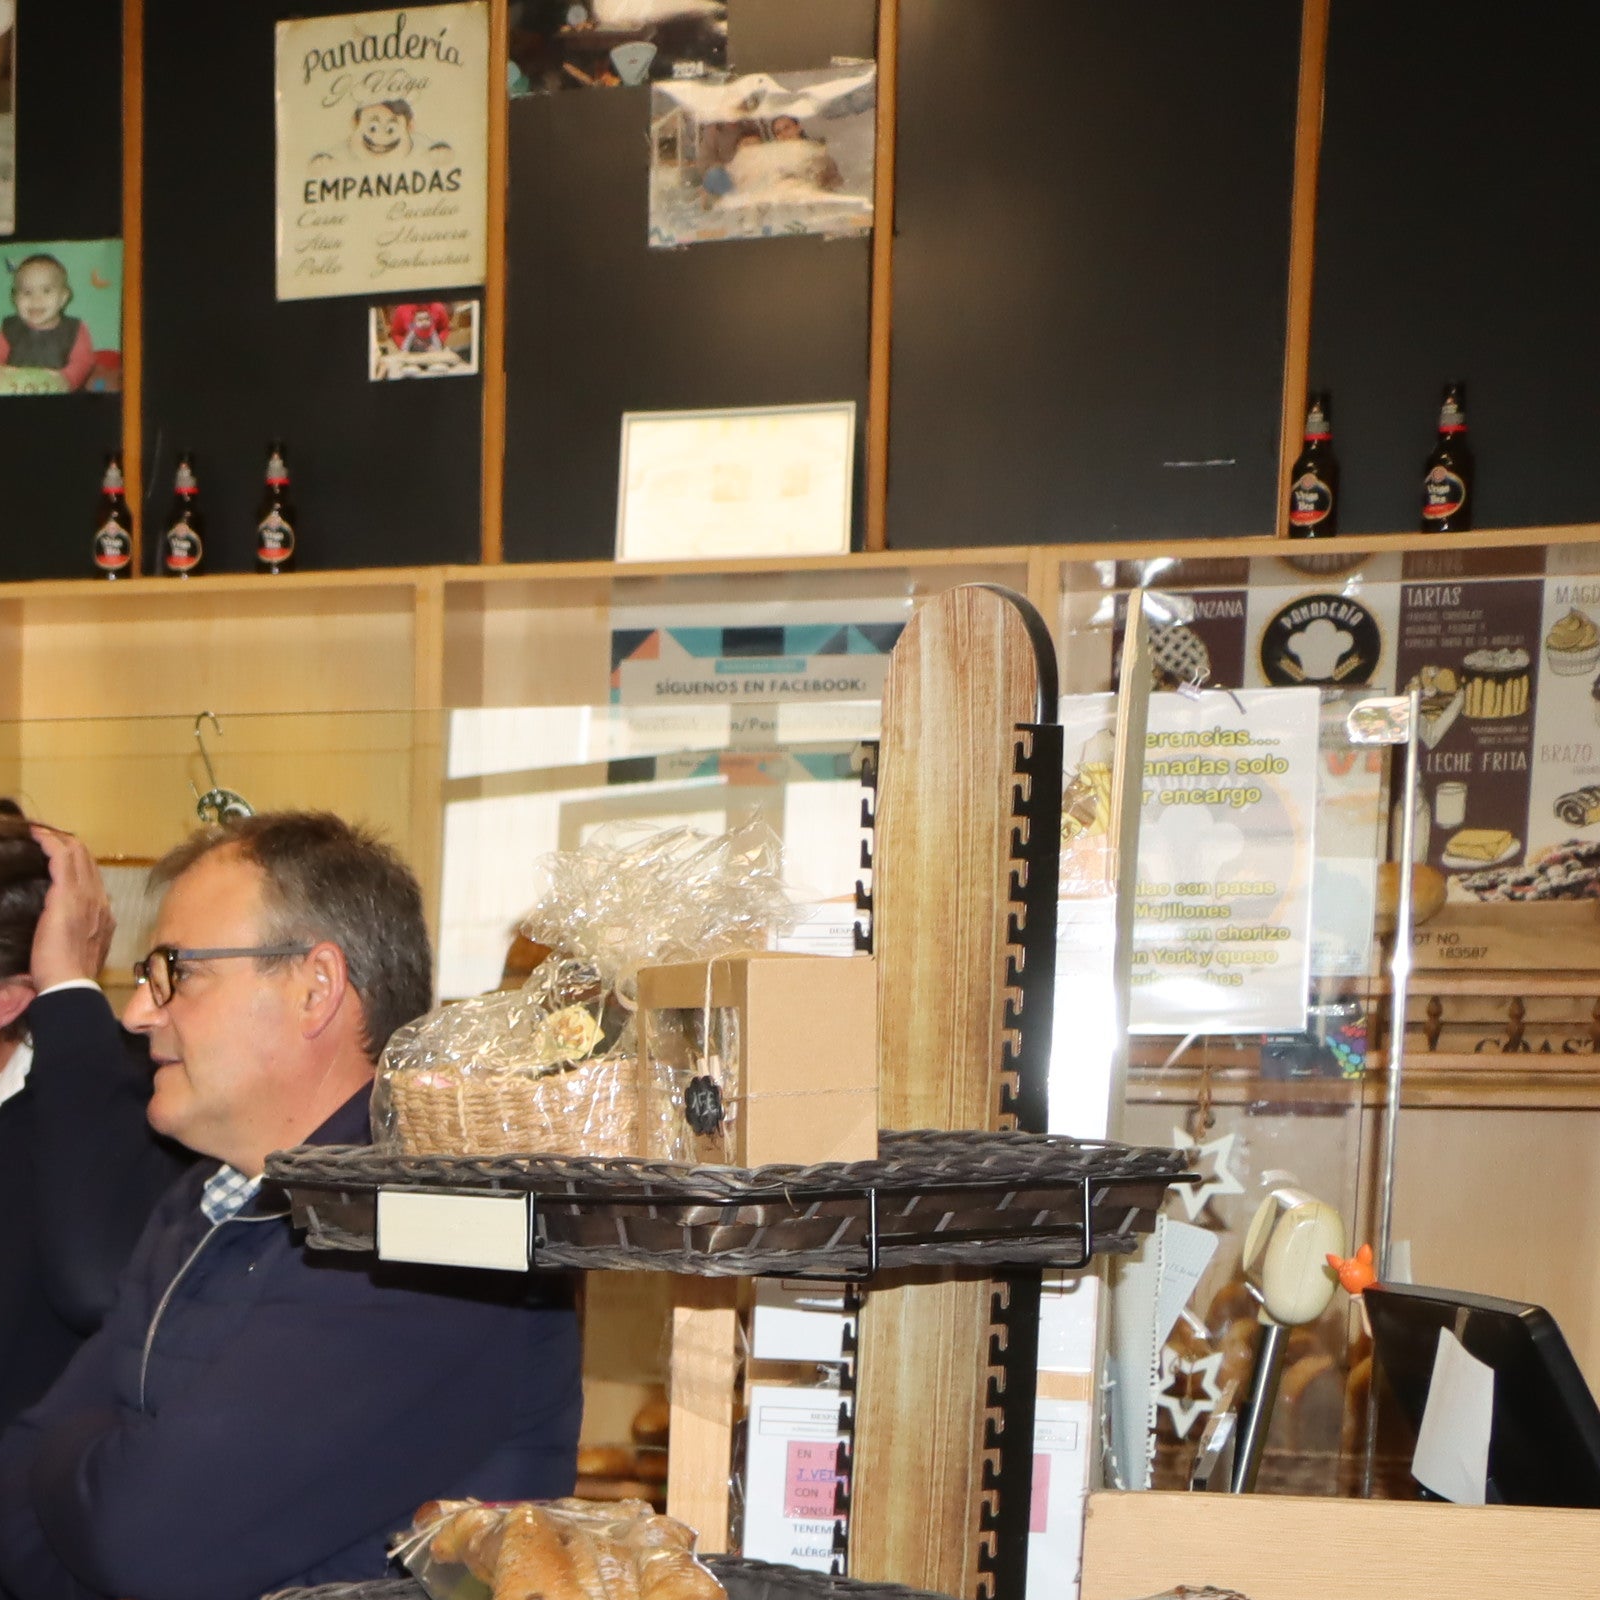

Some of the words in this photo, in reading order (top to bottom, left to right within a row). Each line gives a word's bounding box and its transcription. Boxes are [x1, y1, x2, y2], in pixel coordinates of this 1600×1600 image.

[304, 168, 462, 204] EMPANADAS
[1407, 586, 1462, 607] TARTAS
[656, 678, 738, 696] SÍGUENOS
[744, 682, 765, 694] EN
[1426, 752, 1472, 772] LECHE
[1482, 751, 1528, 772] FRITA
[1541, 744, 1593, 762] BRAZO
[1142, 757, 1230, 777] anadas
[1235, 754, 1289, 775] solo
[1159, 786, 1263, 809] encargo
[1215, 881, 1277, 900] pasas
[1215, 924, 1291, 942] chorizo
[1154, 949, 1195, 963] York
[1199, 952, 1213, 966] y
[1217, 950, 1279, 967] queso
[794, 1487, 819, 1498] CON
[793, 1504, 833, 1516] CONSU
[792, 1523, 834, 1535] TENEM
